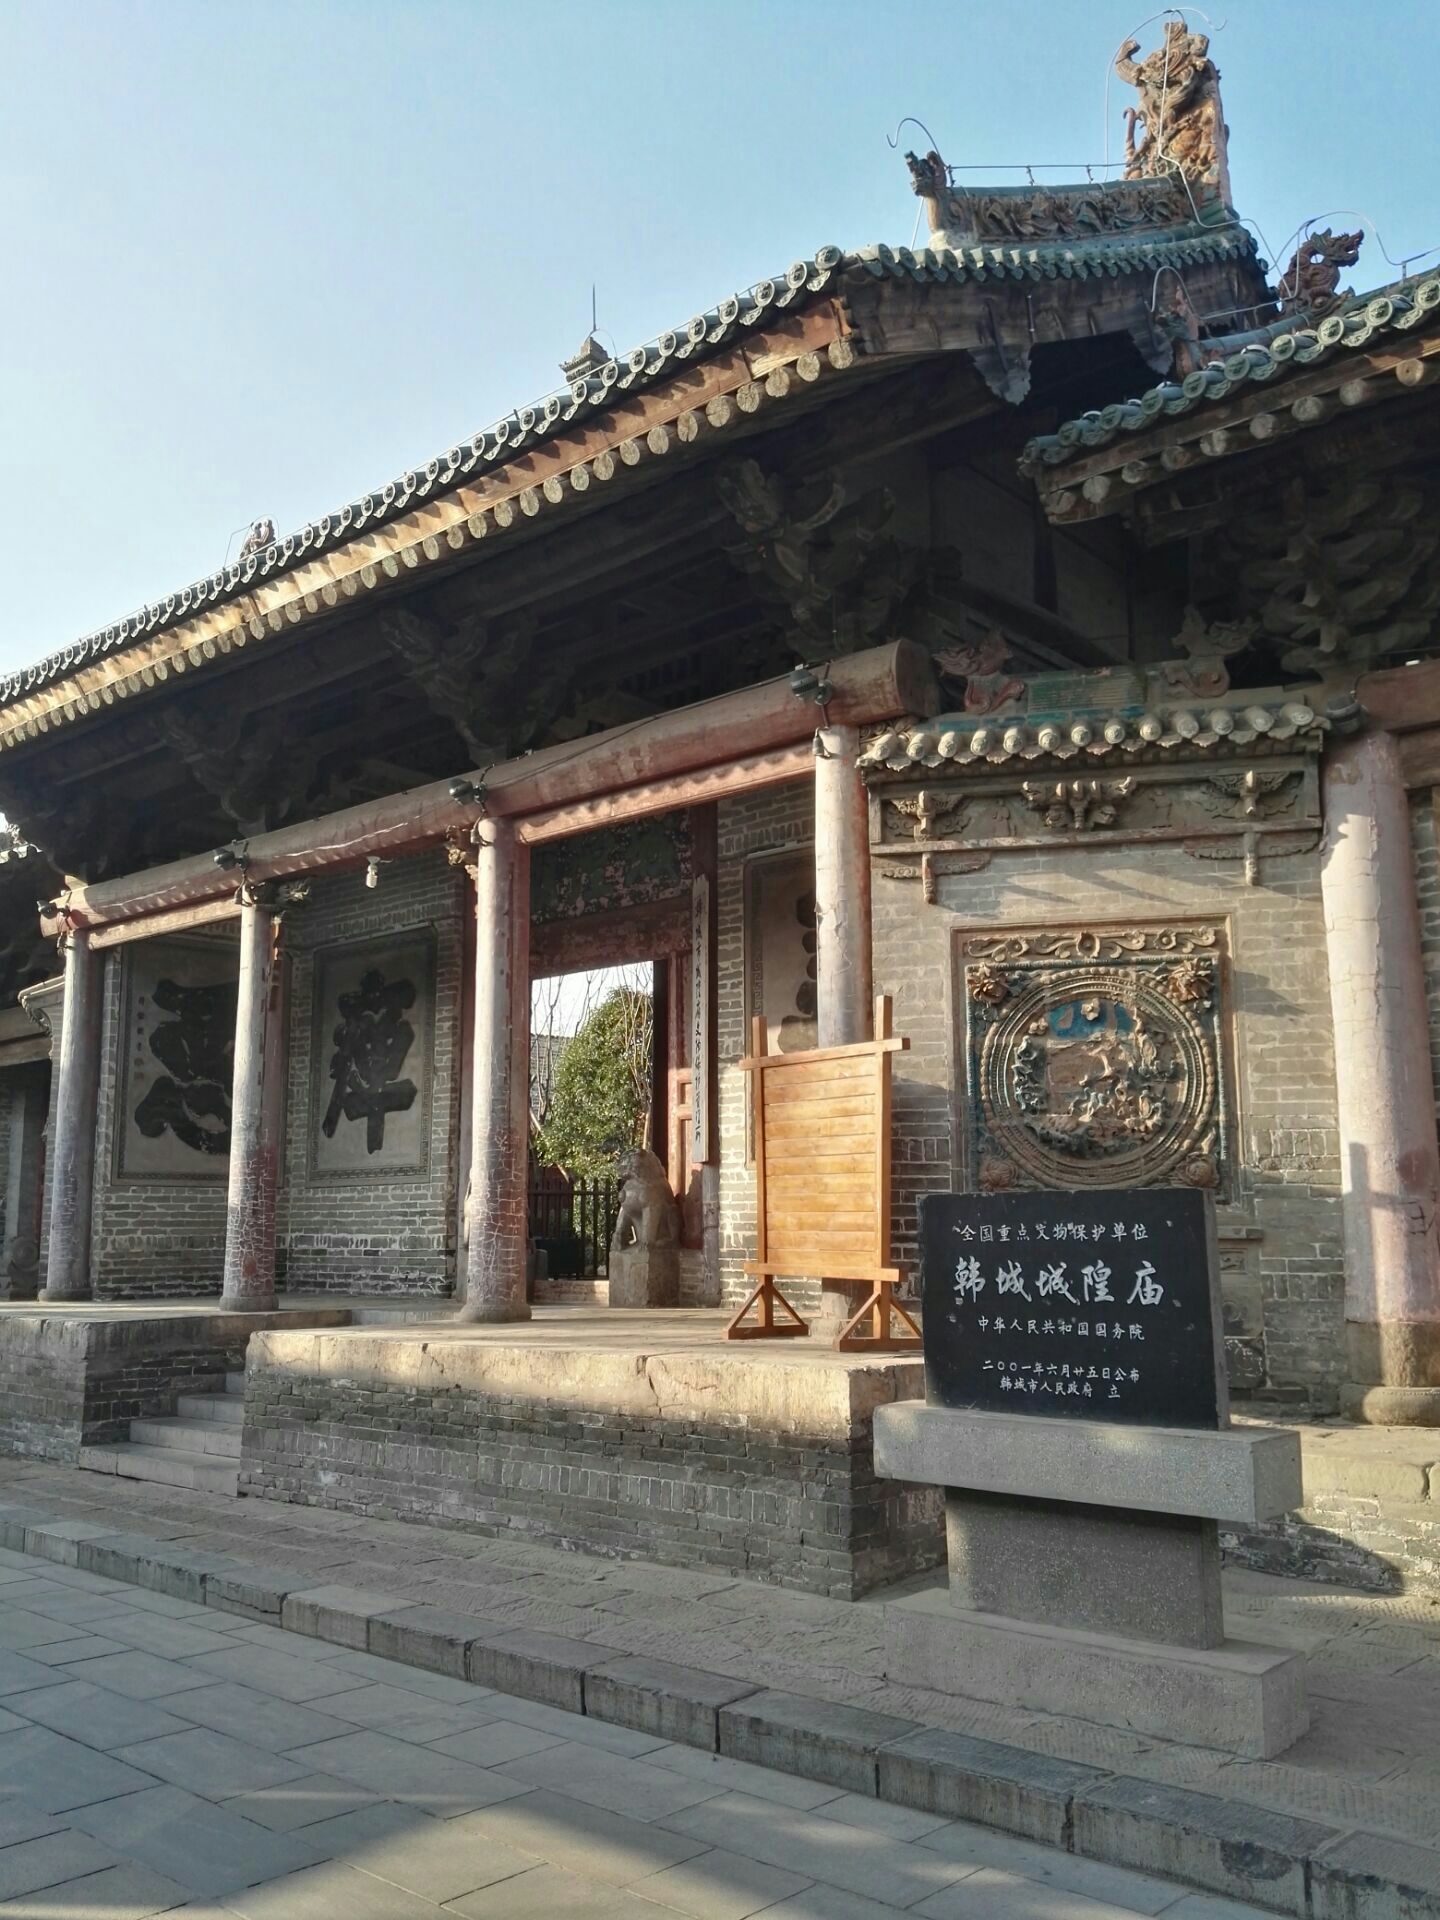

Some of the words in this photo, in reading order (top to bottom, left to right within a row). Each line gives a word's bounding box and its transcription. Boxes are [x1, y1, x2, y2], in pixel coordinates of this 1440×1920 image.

[960, 1223, 1149, 1242] 全国重点文物保护单位
[953, 1256, 1165, 1306] 韩城城隍庙
[978, 1315, 1145, 1341] 中华人民共和国国务院
[1000, 1376, 1093, 1397] 韩城市人民政府
[1107, 1384, 1121, 1399] 立
